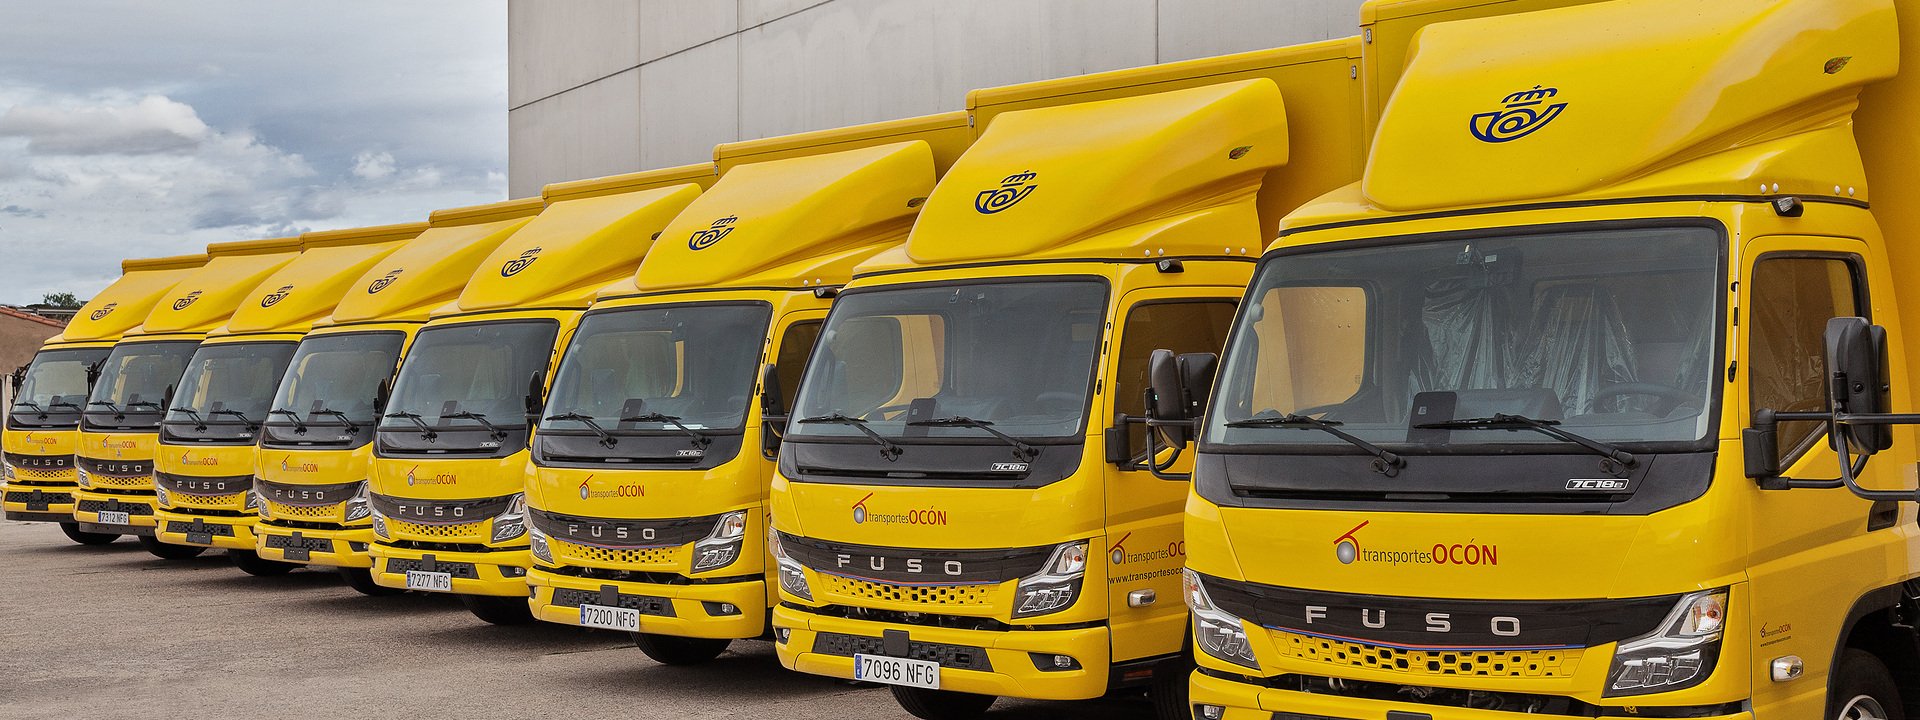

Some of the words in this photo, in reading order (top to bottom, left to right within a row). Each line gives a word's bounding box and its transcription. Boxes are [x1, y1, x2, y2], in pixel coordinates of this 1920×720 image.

[22, 458, 64, 467] FUSO
[97, 464, 142, 473] FUSO
[176, 480, 225, 490] FUSO
[275, 489, 324, 500] FUSO
[101, 512, 116, 524] 7312
[398, 505, 464, 517] FUSO
[568, 524, 656, 540] FUSO
[837, 554, 962, 576] FUSO
[412, 572, 431, 588] 7277
[433, 574, 449, 590] NFG
[587, 608, 612, 626] 7200
[615, 612, 635, 628] NFG
[1305, 605, 1521, 637] FUSO
[864, 658, 901, 681] 7096
[906, 662, 934, 685] NFG
